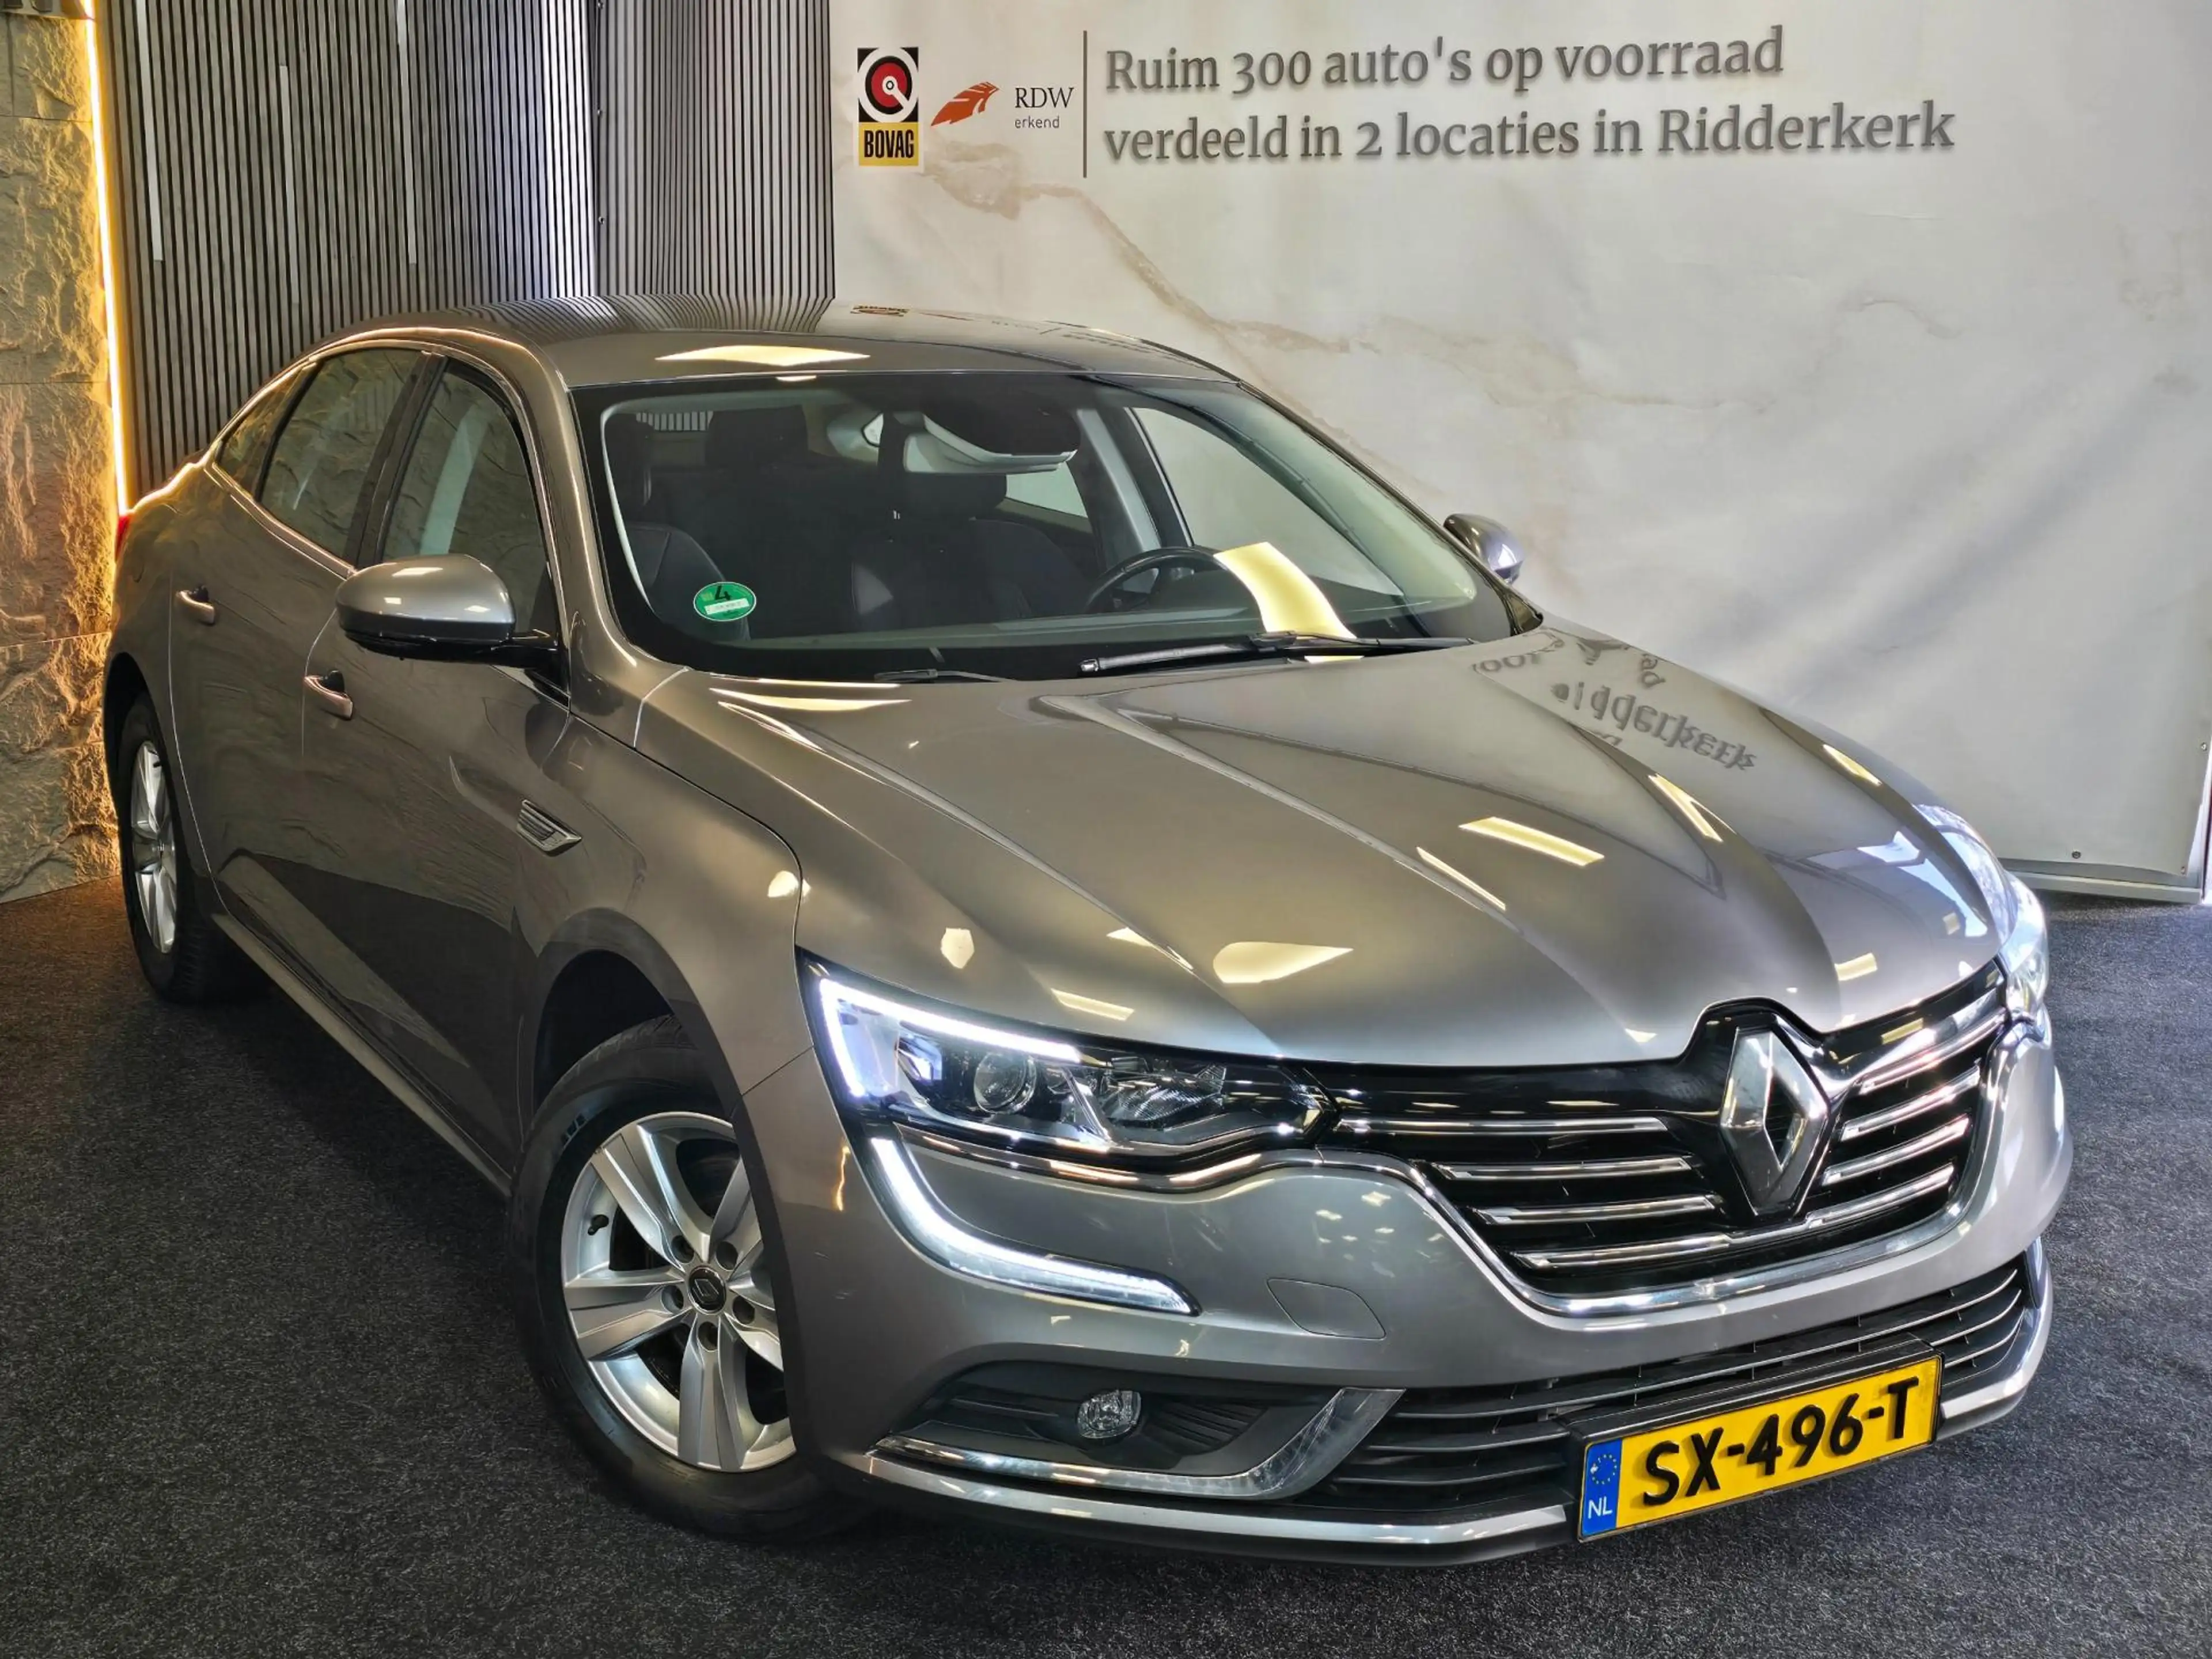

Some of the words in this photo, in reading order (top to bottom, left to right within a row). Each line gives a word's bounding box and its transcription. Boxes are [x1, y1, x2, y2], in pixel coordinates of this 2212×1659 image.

[1105, 47, 1220, 91] Ruim
[1232, 50, 1312, 94] 300
[1324, 36, 1472, 85] auto's
[1486, 45, 1543, 92] op
[1555, 24, 1785, 78] voorraad
[1014, 86, 1074, 109] RDW
[1014, 115, 1060, 129] erkend
[1104, 115, 1290, 162] verdeeld
[1300, 115, 1342, 156] in
[1355, 120, 1383, 156] 2
[1396, 109, 1580, 157] locaties
[1593, 108, 1643, 154] in
[1658, 100, 1956, 153] Ridderkerk
[863, 128, 915, 160] BOVAG
[714, 585, 731, 600] 4
[1642, 1376, 1919, 1507] SX-496-T
[1588, 1497, 1613, 1519] NL
